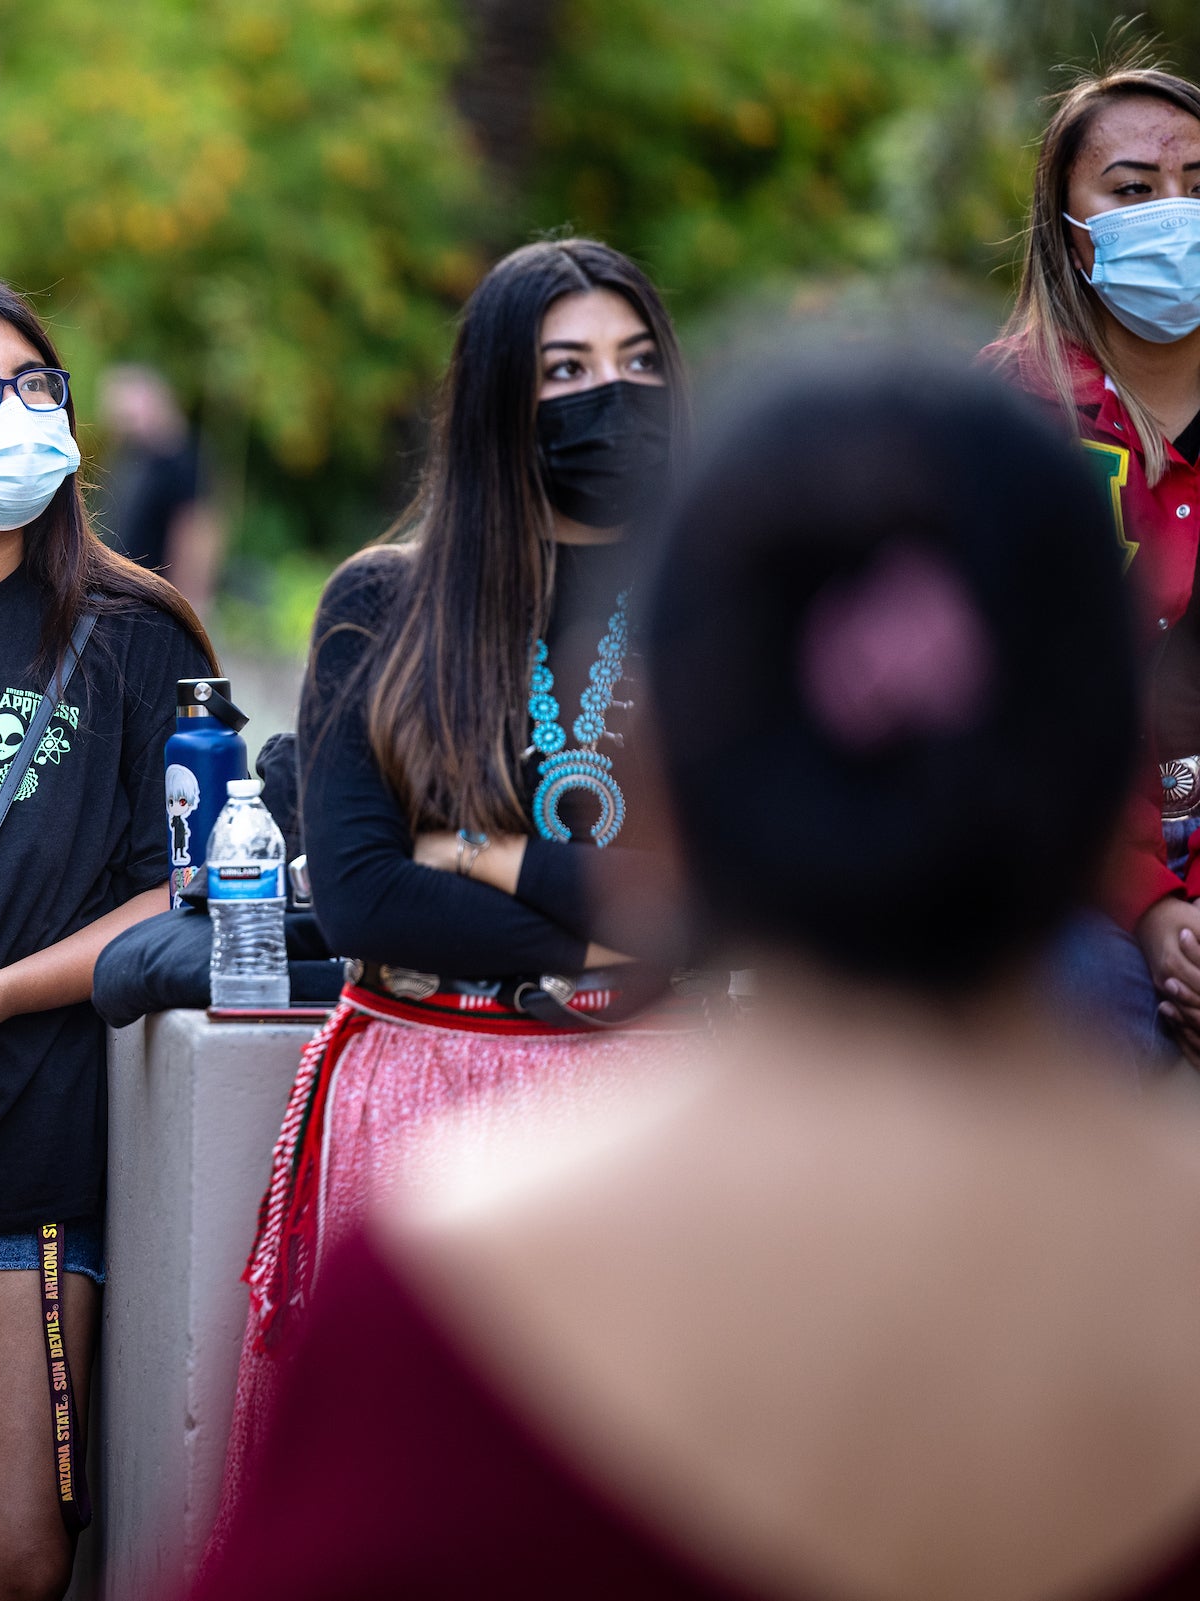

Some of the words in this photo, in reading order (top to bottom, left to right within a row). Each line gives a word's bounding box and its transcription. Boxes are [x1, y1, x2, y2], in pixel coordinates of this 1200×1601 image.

[43, 1241, 59, 1300] ARIZONA
[52, 1360, 68, 1391] SUN
[57, 1443, 73, 1502] ARIZONA
